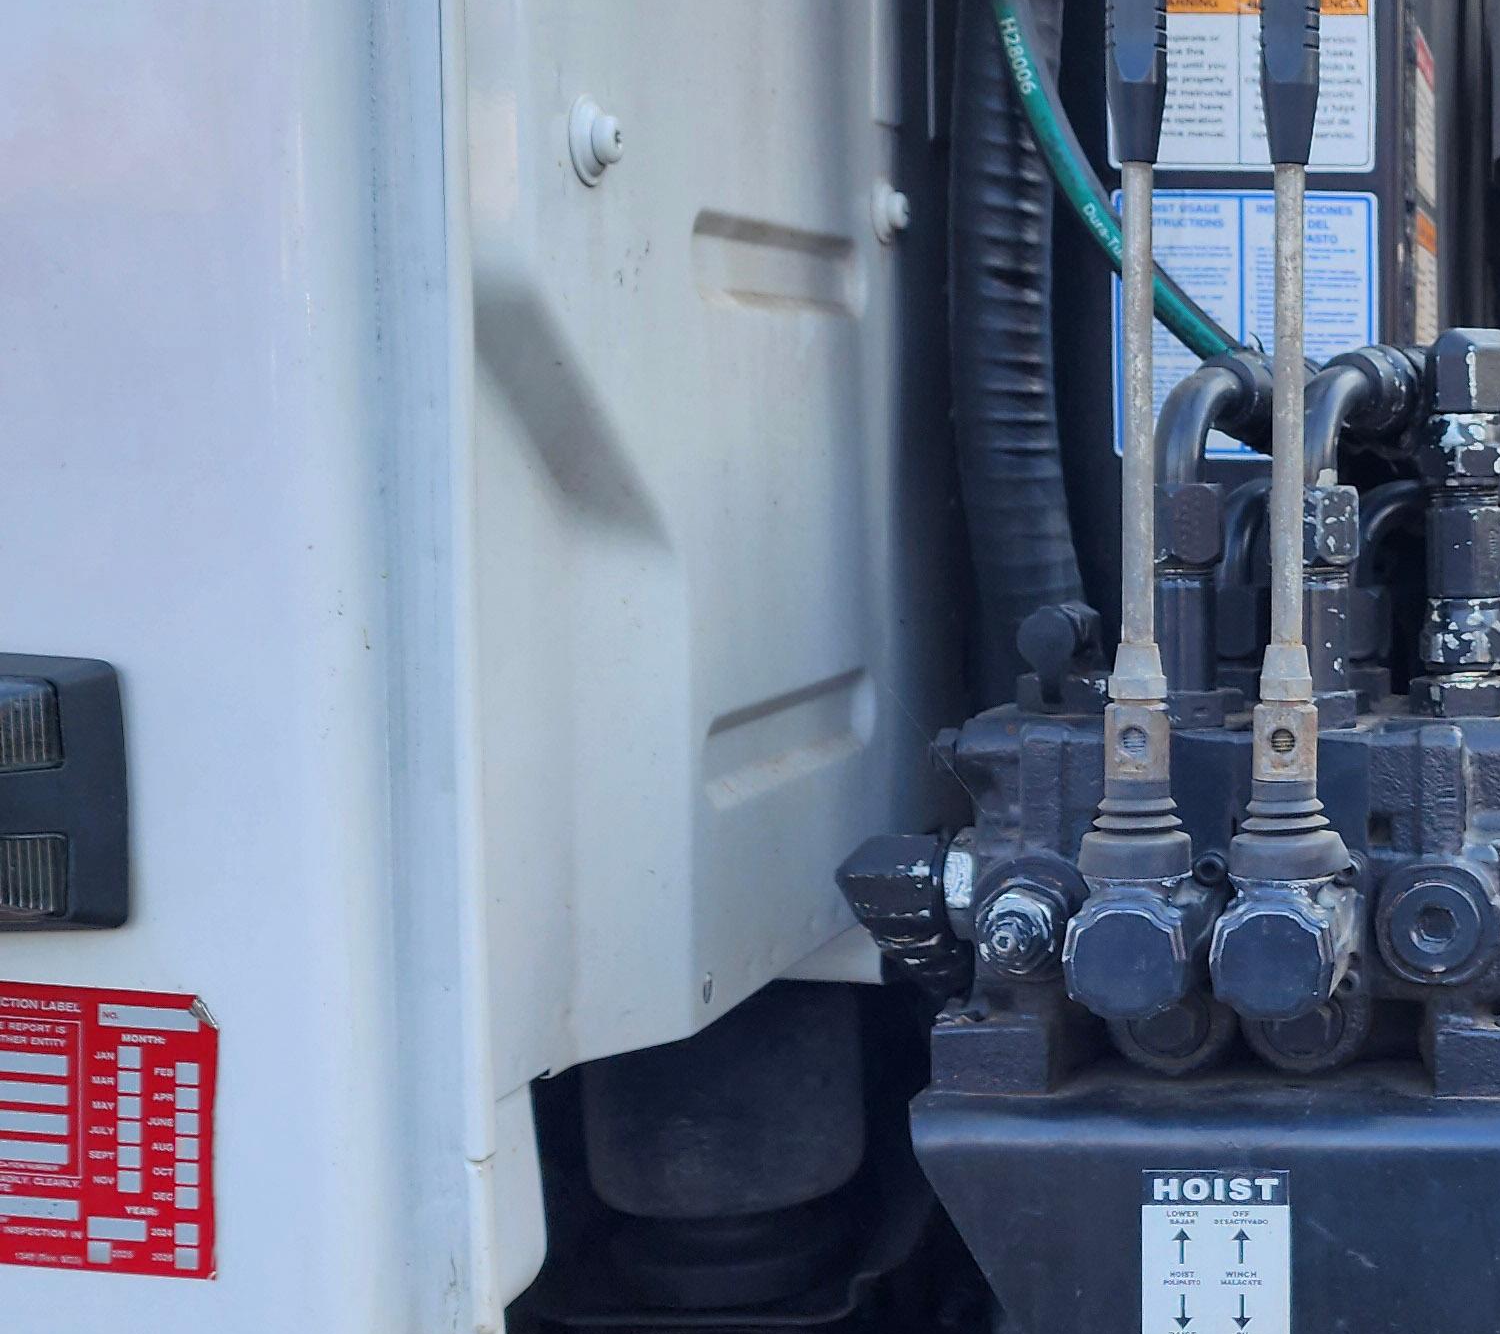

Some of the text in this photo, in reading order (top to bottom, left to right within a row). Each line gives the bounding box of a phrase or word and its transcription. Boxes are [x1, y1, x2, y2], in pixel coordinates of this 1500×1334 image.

[1000, 17, 1037, 96] H28006
[1151, 218, 1224, 229] STRUCTIONS
[41, 999, 82, 1013] LABEL
[1153, 1177, 1280, 1202] HOIST
[1166, 1210, 1199, 1218] LOWER
[1232, 1210, 1251, 1218] OFF
